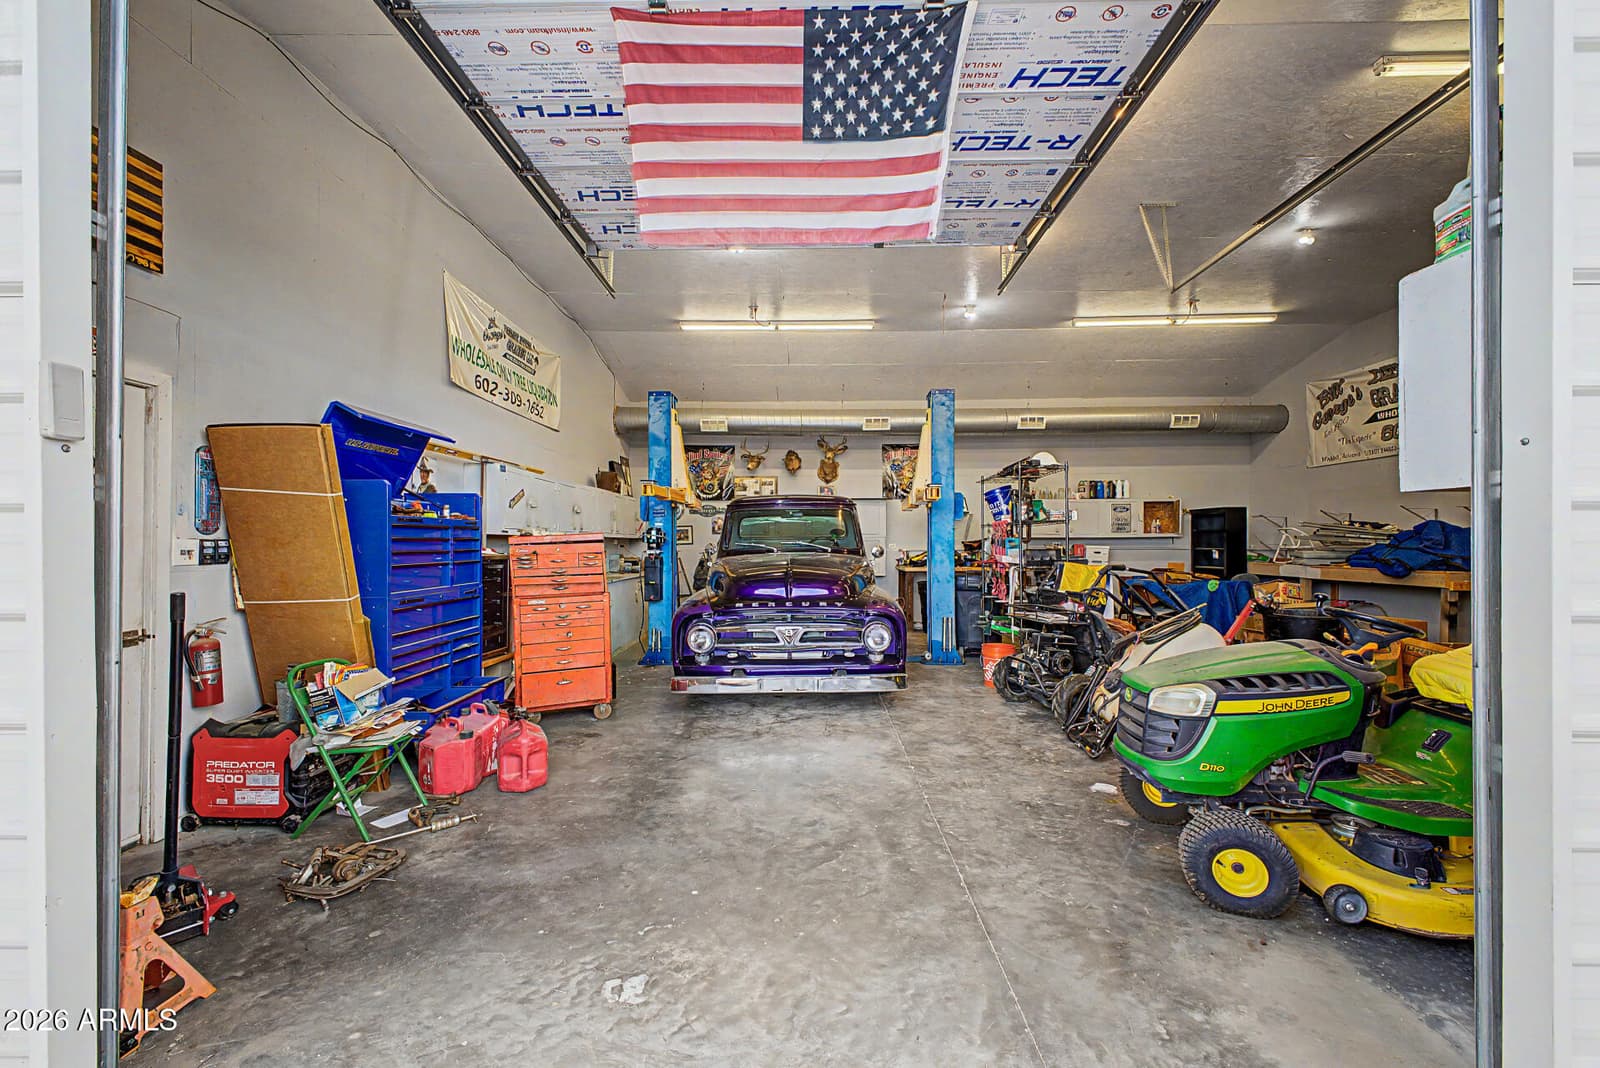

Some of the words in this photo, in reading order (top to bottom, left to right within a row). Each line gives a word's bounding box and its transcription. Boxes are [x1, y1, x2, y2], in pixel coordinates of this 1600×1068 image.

[474, 374, 544, 418] 602-309-1652
[1257, 702, 1293, 712] JOHN
[1295, 697, 1335, 709] DEERE
[206, 760, 275, 768] PREDATOR
[1199, 763, 1225, 773] D110
[206, 774, 244, 784] 3500
